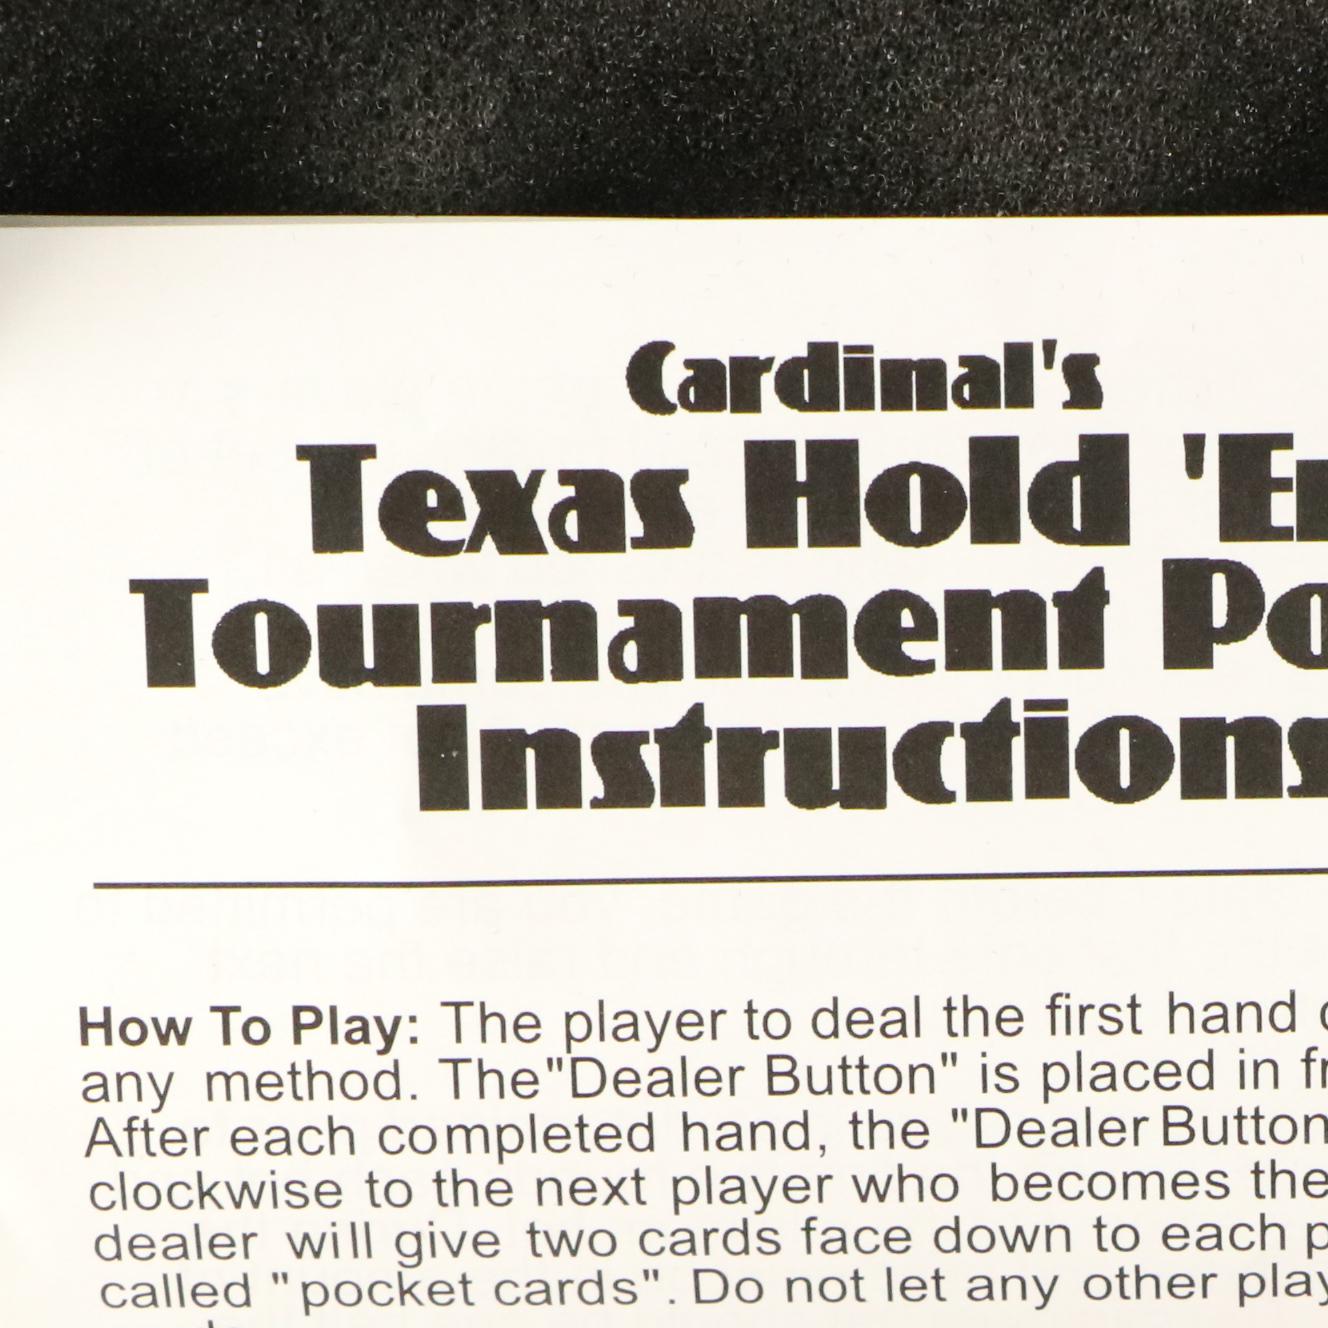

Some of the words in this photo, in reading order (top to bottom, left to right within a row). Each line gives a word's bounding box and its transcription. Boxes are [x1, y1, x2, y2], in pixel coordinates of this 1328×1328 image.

[625, 339, 1103, 416] Cardinal's
[296, 443, 696, 558] Texas
[743, 432, 1131, 550] Hold
[128, 564, 1111, 690] Tournament
[78, 1005, 193, 1047] How
[209, 1005, 272, 1047] To
[291, 1004, 418, 1057] Play:
[440, 1000, 542, 1044] The
[564, 999, 728, 1055] player
[743, 998, 792, 1041] to
[811, 994, 921, 1040] deal
[942, 993, 1025, 1038] the
[1045, 991, 1143, 1037] first
[1168, 989, 1297, 1035] hand
[81, 1071, 175, 1114] any
[205, 1058, 418, 1102] method.
[766, 1051, 958, 1097] Button"
[980, 1051, 1020, 1094] is
[1042, 1047, 1215, 1105] placed
[1238, 1047, 1279, 1091] in
[84, 1115, 210, 1158] After
[230, 1114, 356, 1157] each
[378, 1111, 655, 1166] completed
[681, 1109, 826, 1158] hand,
[848, 1108, 930, 1151] the
[951, 1106, 1150, 1149] "Dealer
[89, 1169, 343, 1212] clockwise
[364, 1170, 413, 1209] to
[431, 1167, 514, 1208] the
[536, 1167, 648, 1207] next
[671, 1164, 834, 1216] player
[851, 1162, 960, 1204] who
[990, 1161, 1231, 1203] becomes
[94, 1222, 259, 1262] dealer
[285, 1221, 373, 1260] will
[394, 1220, 501, 1269] give
[525, 1221, 618, 1258] two
[638, 1217, 782, 1257] cards
[800, 1215, 912, 1255] face
[933, 1215, 1071, 1254] down
[1092, 1215, 1141, 1253] to
[1161, 1212, 1286, 1252] each
[100, 1272, 252, 1309] called
[271, 1270, 475, 1317] "pocket
[494, 1268, 676, 1306] cards".
[692, 1268, 764, 1305] Do
[785, 1268, 867, 1303] not
[885, 1266, 947, 1303] let
[966, 1274, 1059, 1311] any
[1083, 1263, 1219, 1301] other
